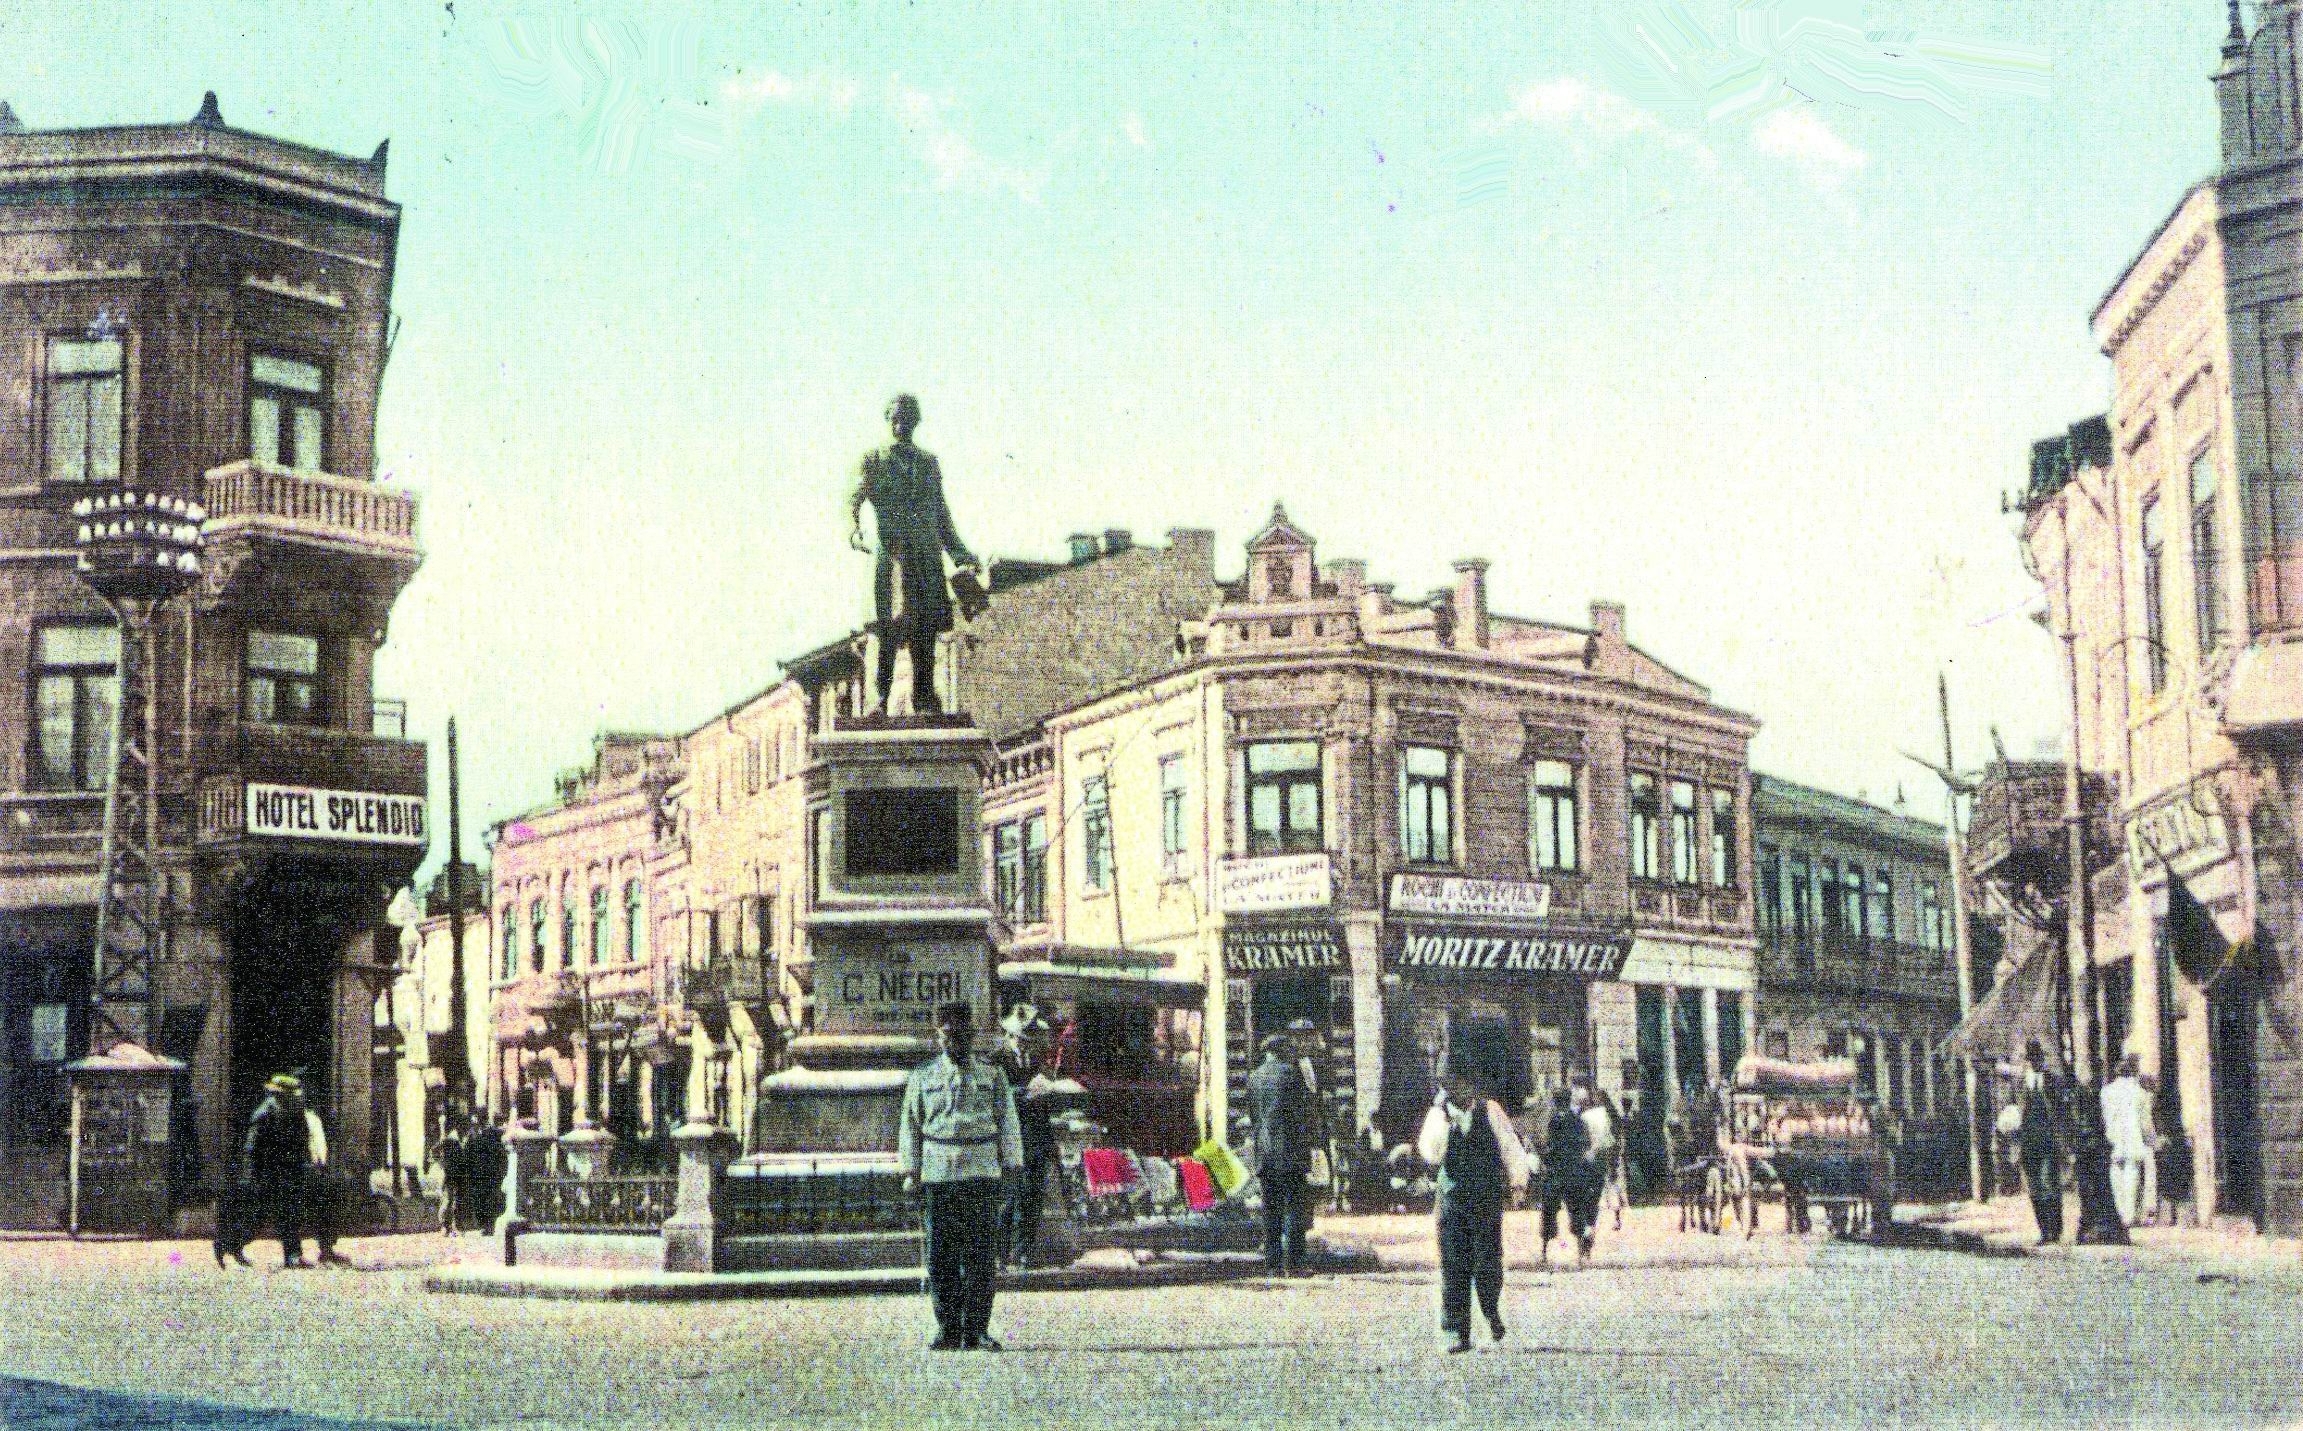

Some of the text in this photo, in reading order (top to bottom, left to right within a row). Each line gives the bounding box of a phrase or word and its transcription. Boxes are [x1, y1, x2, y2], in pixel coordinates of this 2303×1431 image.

[256, 789, 424, 839] HOTEL SPLENDID
[1226, 943, 1341, 970] KRAMER
[1398, 933, 1621, 972] MORITZ KRAMER
[878, 969, 962, 1002] NEGRI
